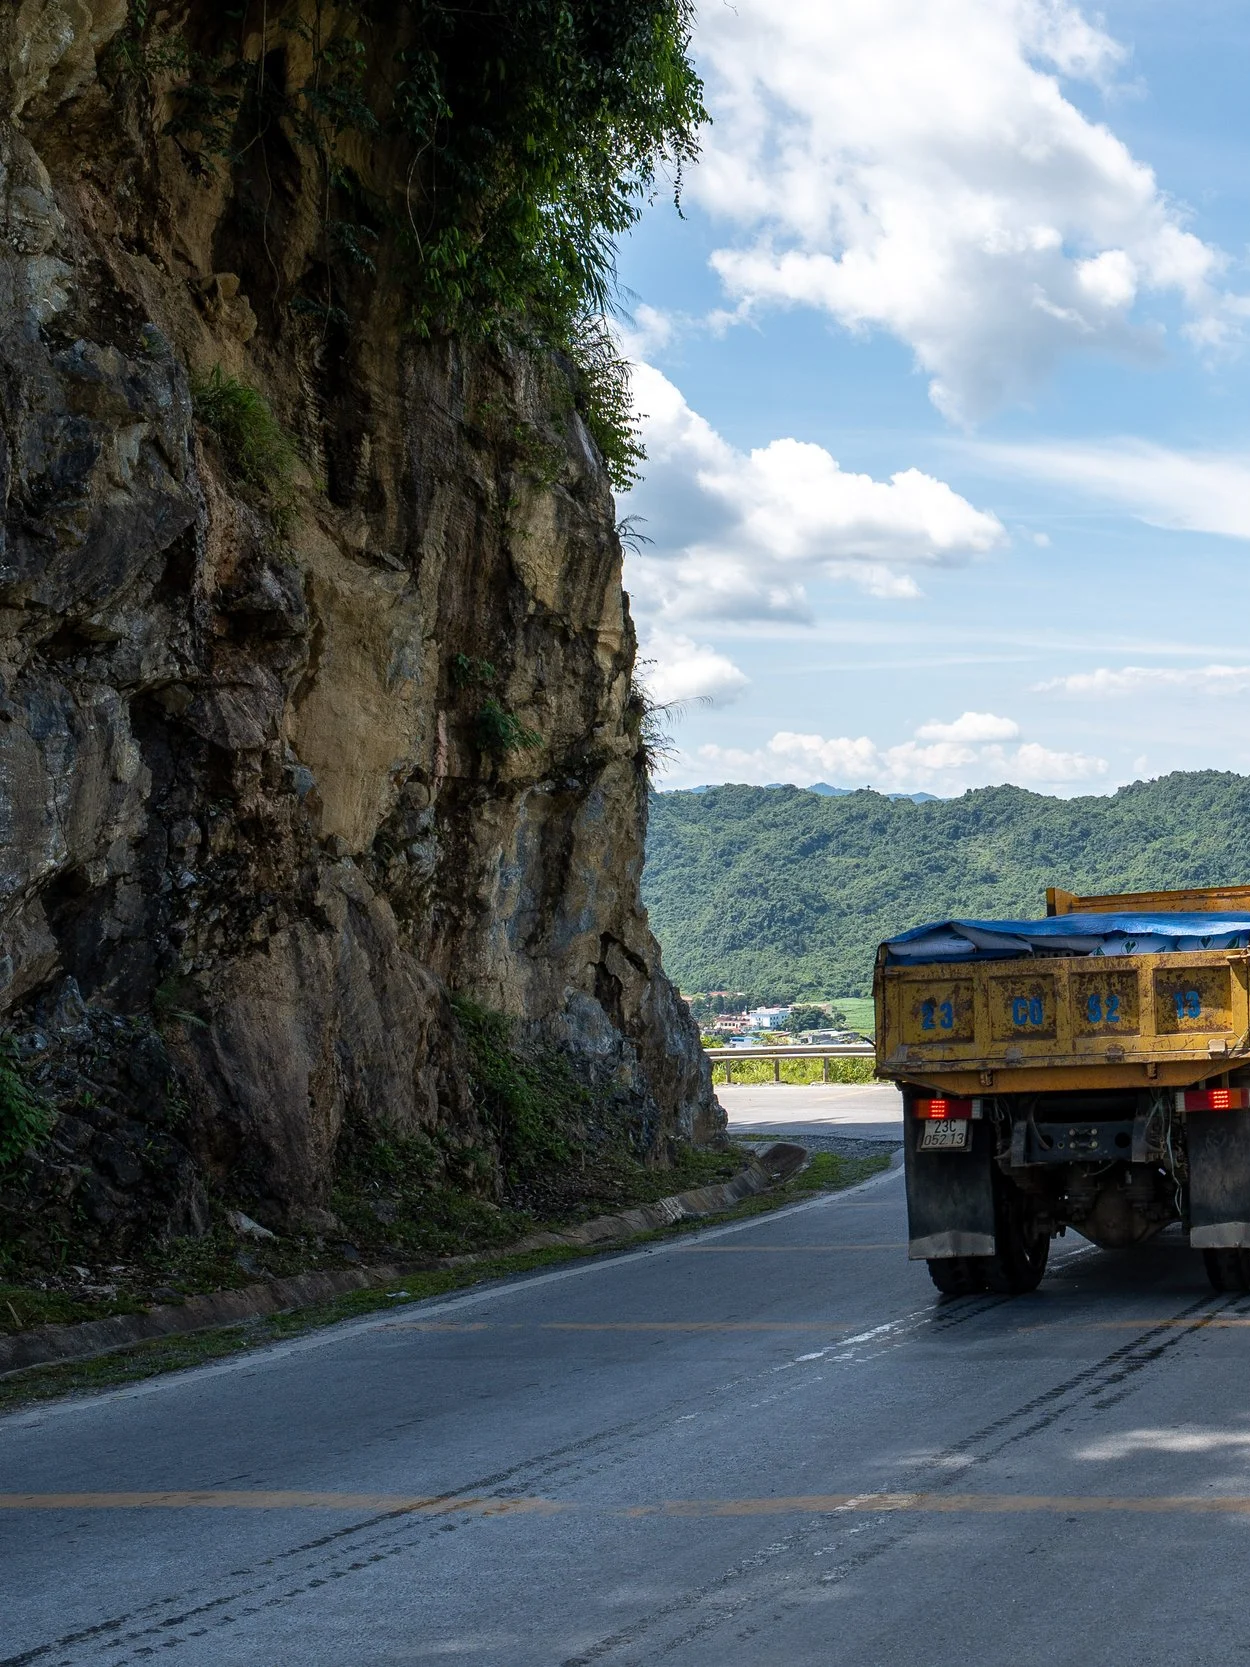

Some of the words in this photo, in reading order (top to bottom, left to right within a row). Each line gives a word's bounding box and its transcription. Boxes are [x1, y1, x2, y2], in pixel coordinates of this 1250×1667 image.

[920, 999, 954, 1031] 23
[1173, 990, 1202, 1019] 13
[934, 1119, 956, 1133] 23C
[924, 1132, 964, 1146] 052.13
